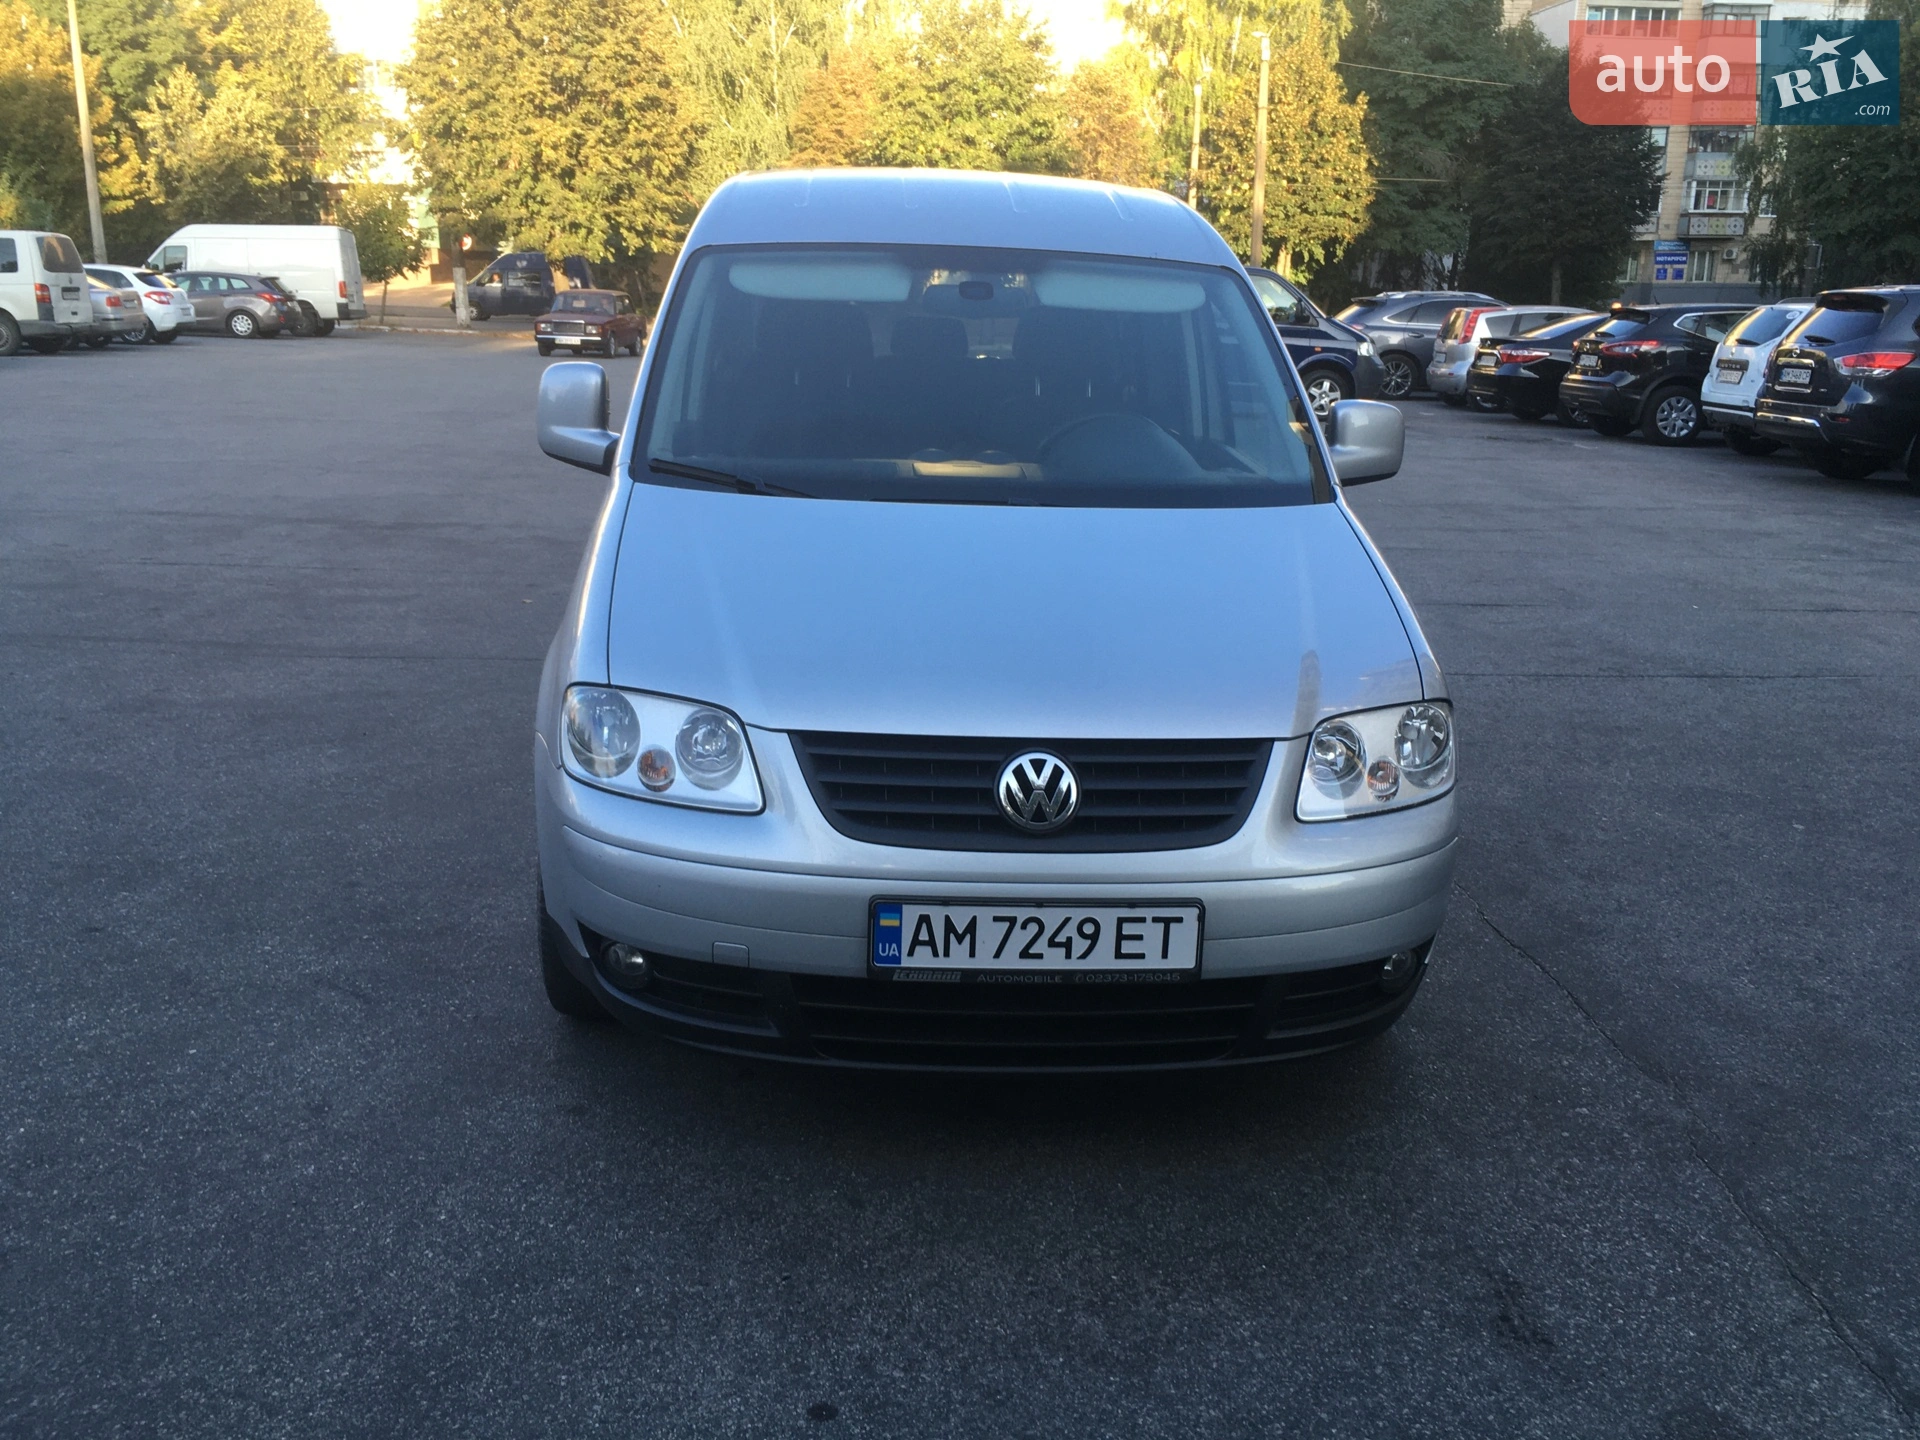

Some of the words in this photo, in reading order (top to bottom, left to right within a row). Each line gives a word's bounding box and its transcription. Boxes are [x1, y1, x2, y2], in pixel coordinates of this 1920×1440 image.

[878, 942, 899, 957] UA
[907, 914, 978, 959] AM
[992, 915, 1102, 960] 7249
[1114, 916, 1184, 960] ET
